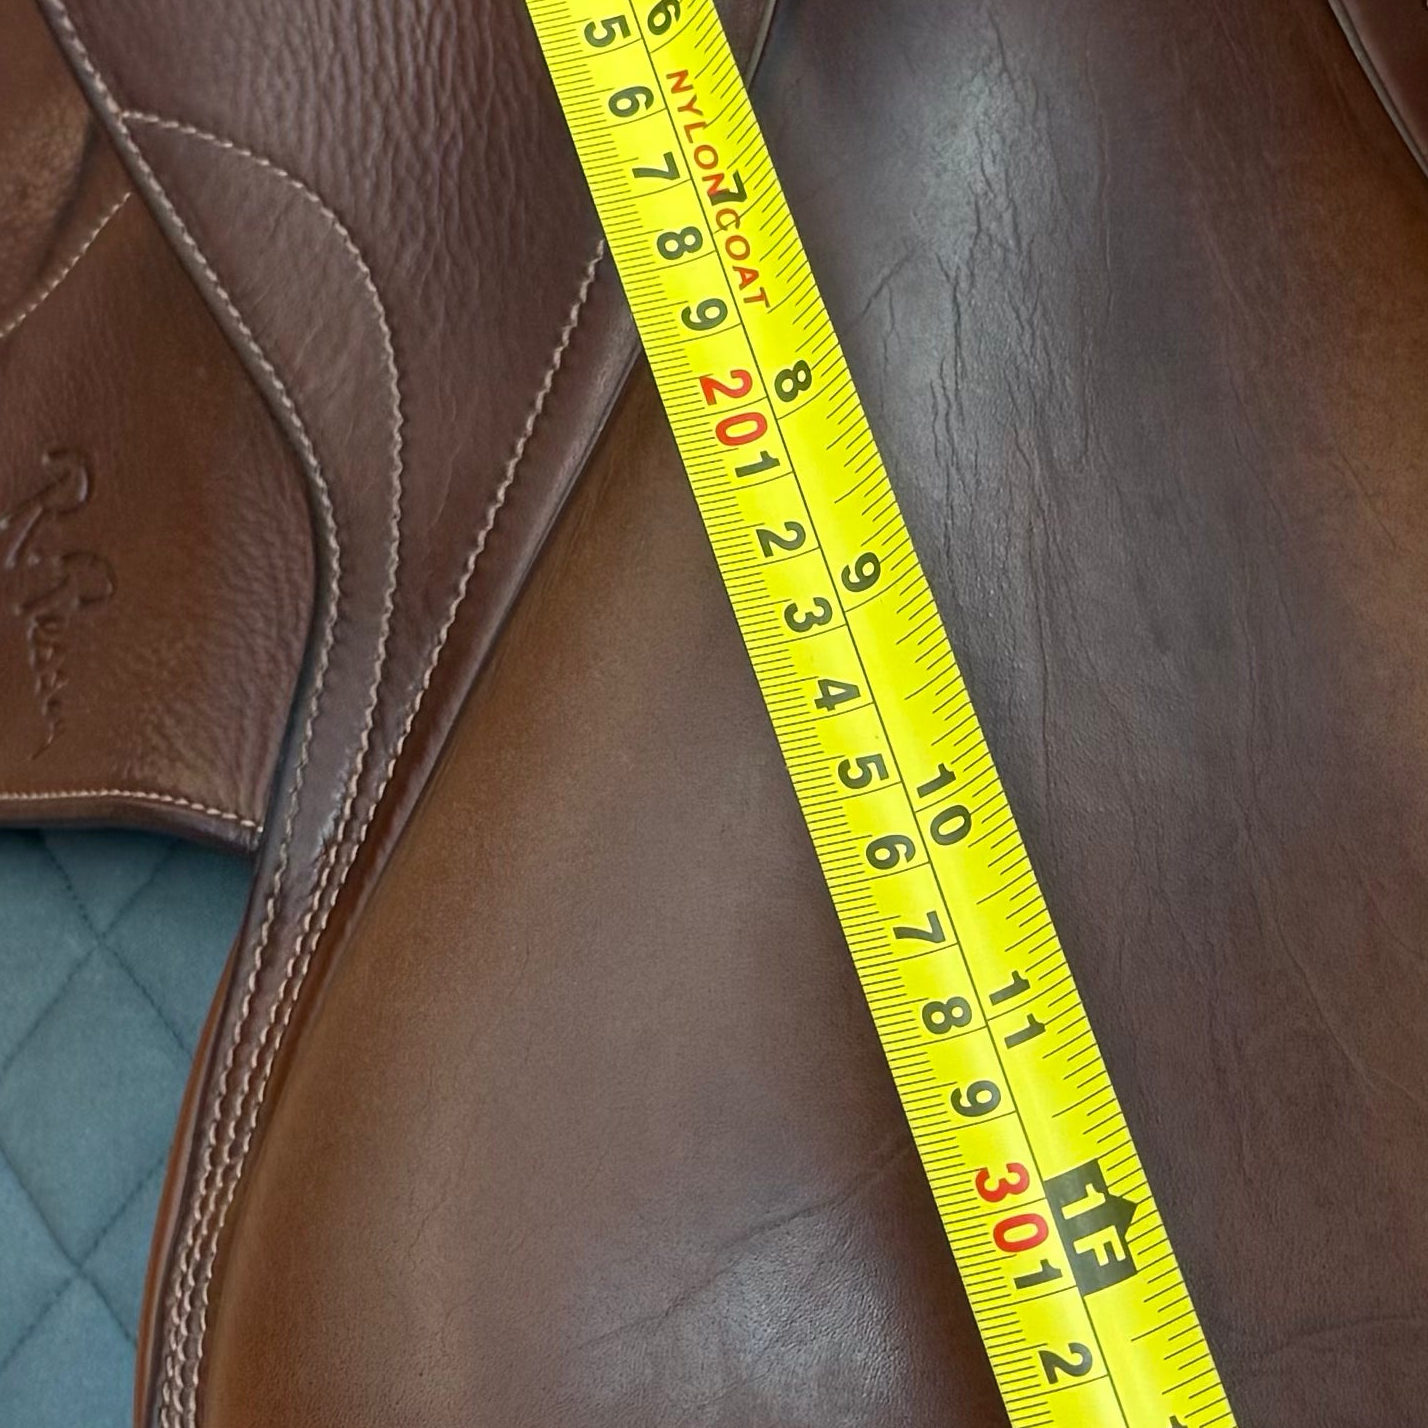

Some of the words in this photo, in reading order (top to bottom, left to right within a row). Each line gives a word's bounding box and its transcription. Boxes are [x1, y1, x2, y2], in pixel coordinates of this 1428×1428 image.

[584, 14, 631, 48] 5
[608, 85, 654, 118] 6
[633, 152, 680, 181] 7
[666, 70, 725, 200] NYLON
[715, 208, 770, 309] COAT
[656, 226, 703, 260] 8
[681, 298, 727, 332] 9
[699, 369, 767, 447] 20
[735, 450, 781, 478] 1
[757, 521, 806, 558] 2
[784, 597, 832, 633] 3
[814, 678, 861, 712] 4
[709, 170, 747, 207] 7
[774, 359, 812, 402] 8
[841, 552, 881, 593] 9
[916, 763, 973, 845] 10
[989, 970, 1046, 1050] 11
[1061, 1183, 1126, 1267] 1F
[838, 753, 889, 790] 5
[865, 834, 916, 870] 6
[893, 910, 946, 944] 7
[922, 996, 972, 1035] 8
[951, 1080, 1002, 1117] 9
[975, 1162, 1049, 1253] 30
[1014, 1258, 1063, 1290] 1
[1038, 1342, 1093, 1385] 2
